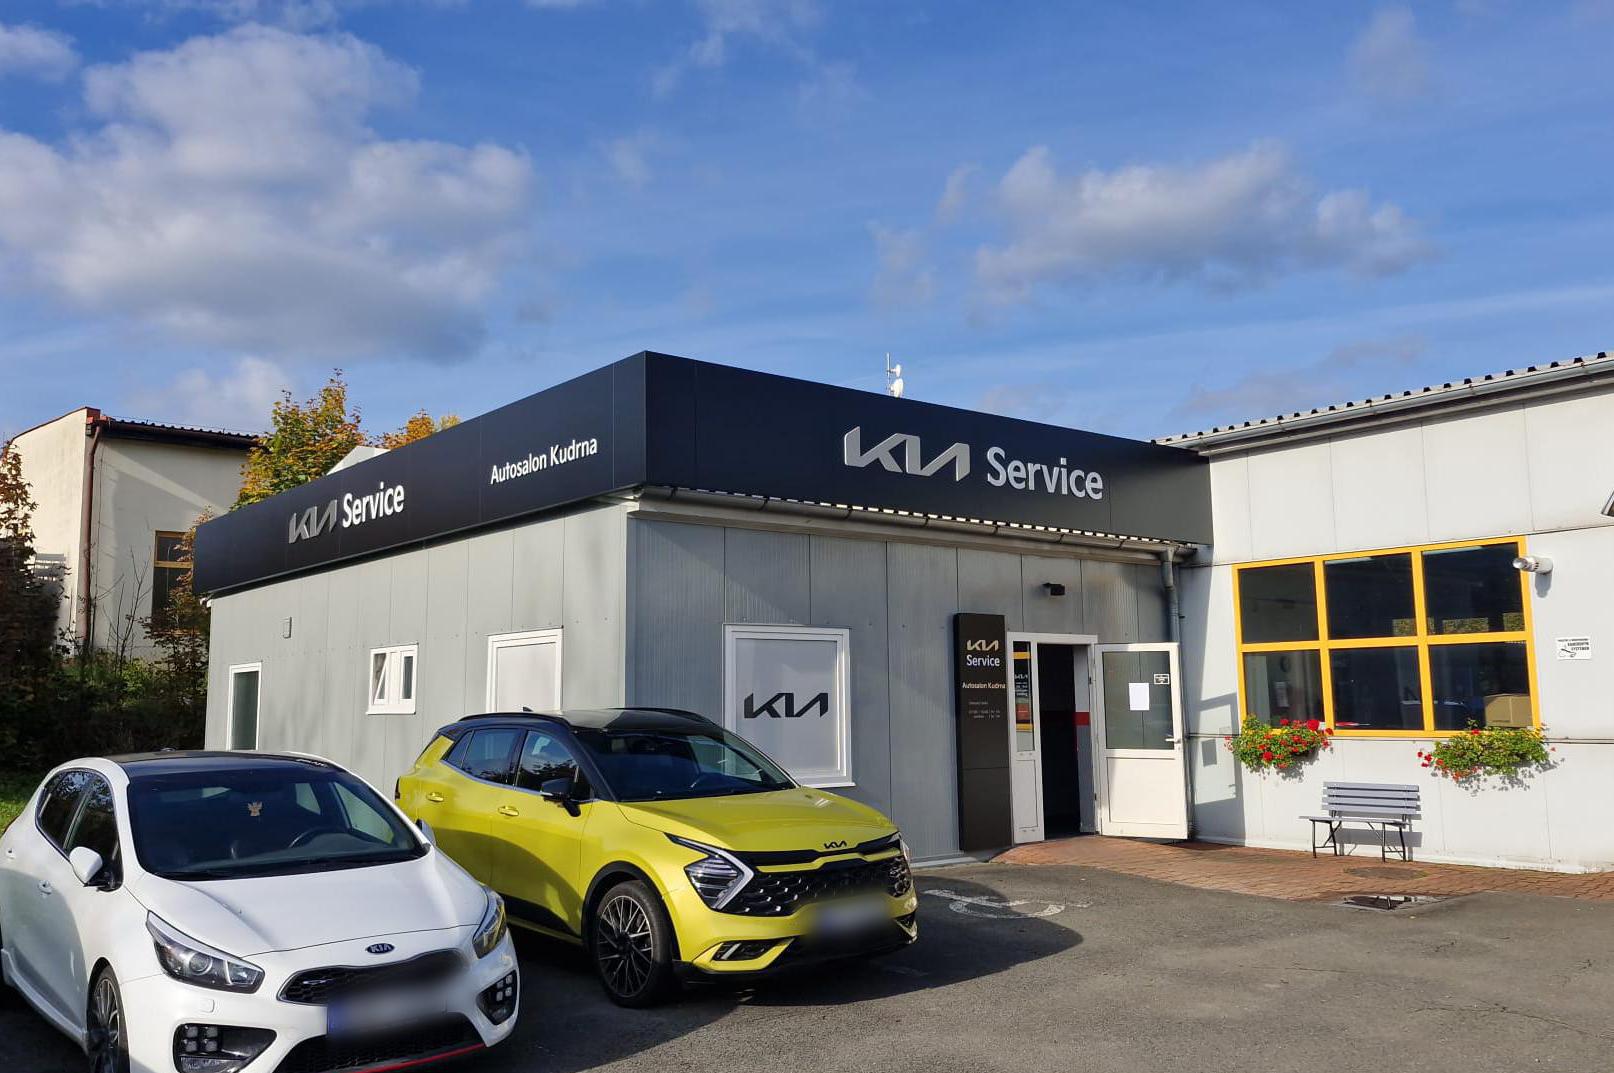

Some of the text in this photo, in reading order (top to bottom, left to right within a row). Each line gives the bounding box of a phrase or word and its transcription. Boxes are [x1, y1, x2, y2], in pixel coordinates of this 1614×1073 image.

[490, 438, 598, 485] Autosalon Kudrna
[843, 425, 1104, 501] KIA Service
[288, 481, 405, 544] KIA Service
[966, 639, 999, 651] KIA
[966, 654, 1001, 667] Service
[743, 692, 829, 719] KIA
[369, 943, 393, 953] KIA
